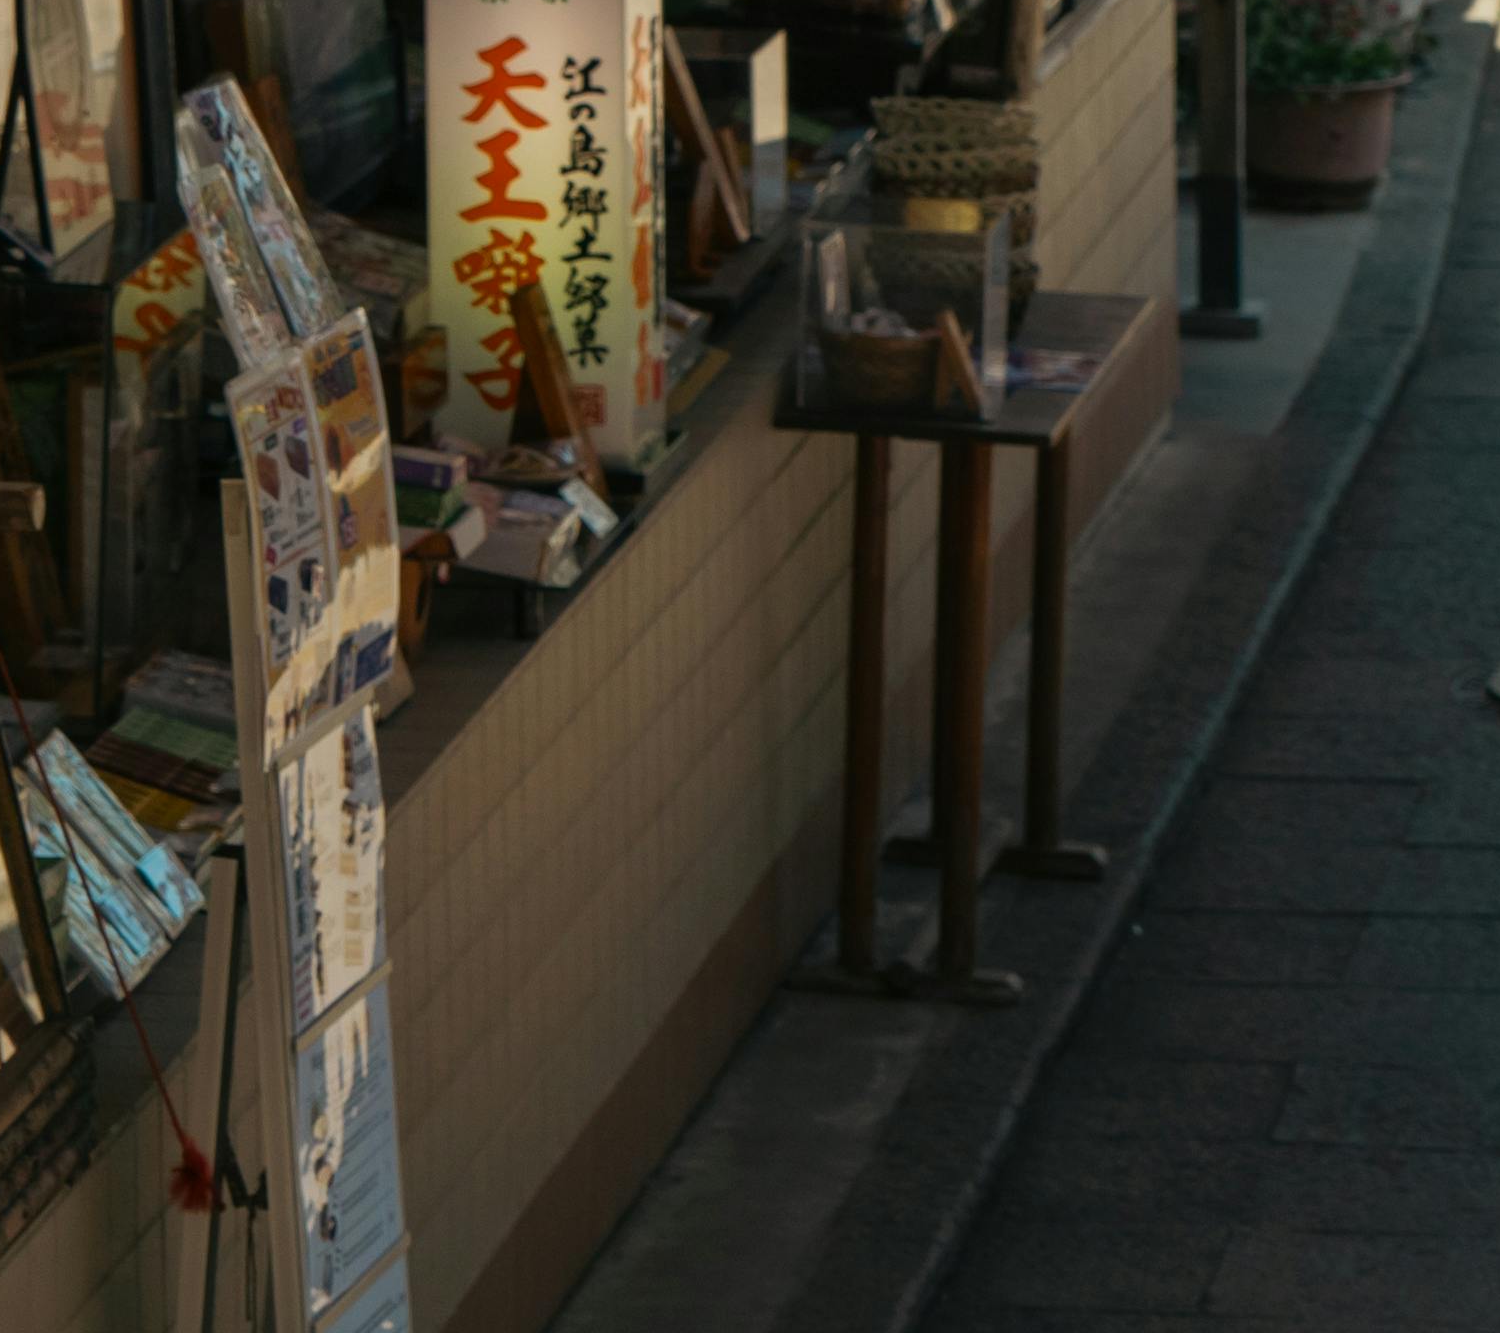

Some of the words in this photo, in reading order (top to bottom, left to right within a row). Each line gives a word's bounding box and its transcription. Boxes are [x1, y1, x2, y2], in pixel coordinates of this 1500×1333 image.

[559, 56, 614, 368] 江の島郷土銘菓
